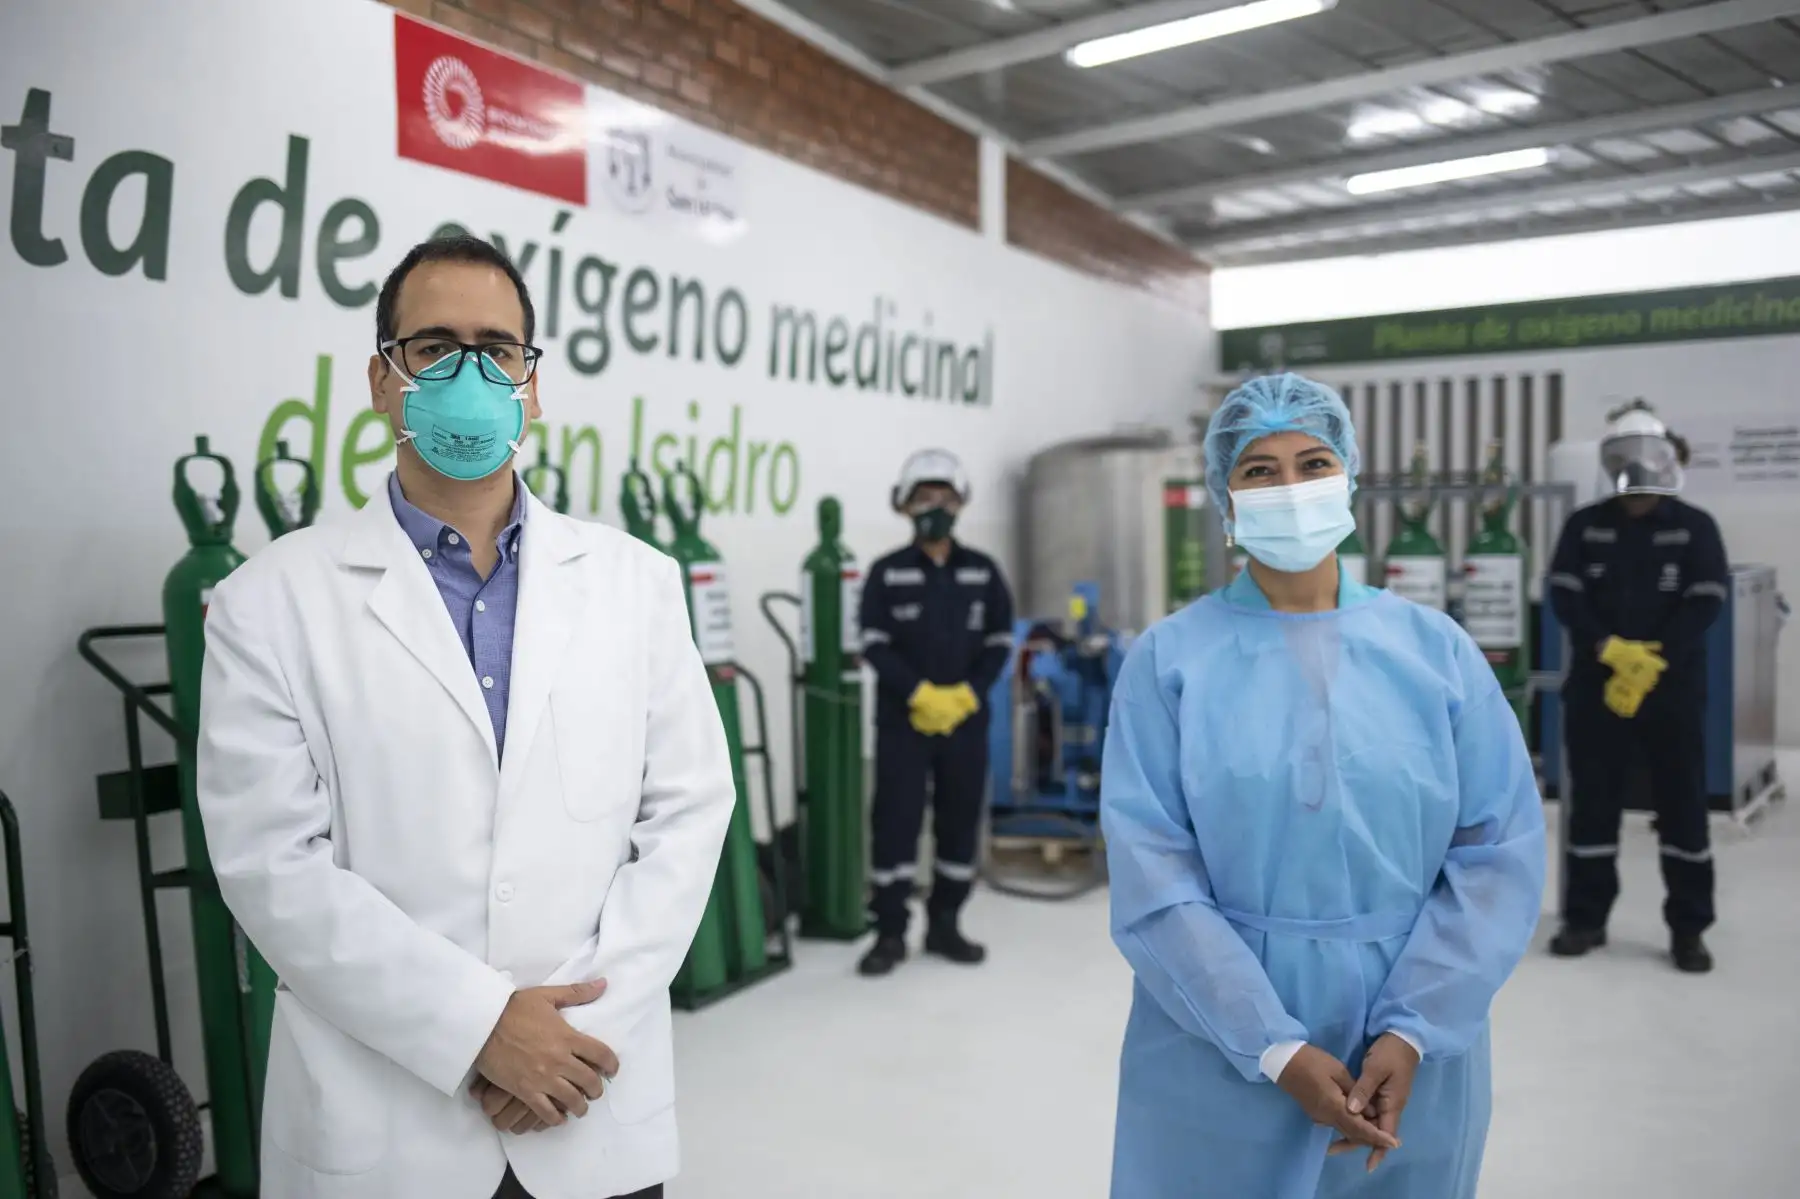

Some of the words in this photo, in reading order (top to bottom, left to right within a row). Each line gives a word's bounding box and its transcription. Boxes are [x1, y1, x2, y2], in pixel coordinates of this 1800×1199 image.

[1, 86, 174, 282] ta
[224, 133, 381, 309] de
[767, 295, 994, 409] medicinal
[1472, 312, 1511, 347] de
[257, 353, 396, 511] de
[526, 418, 604, 516] an
[630, 395, 800, 516] Isidro
